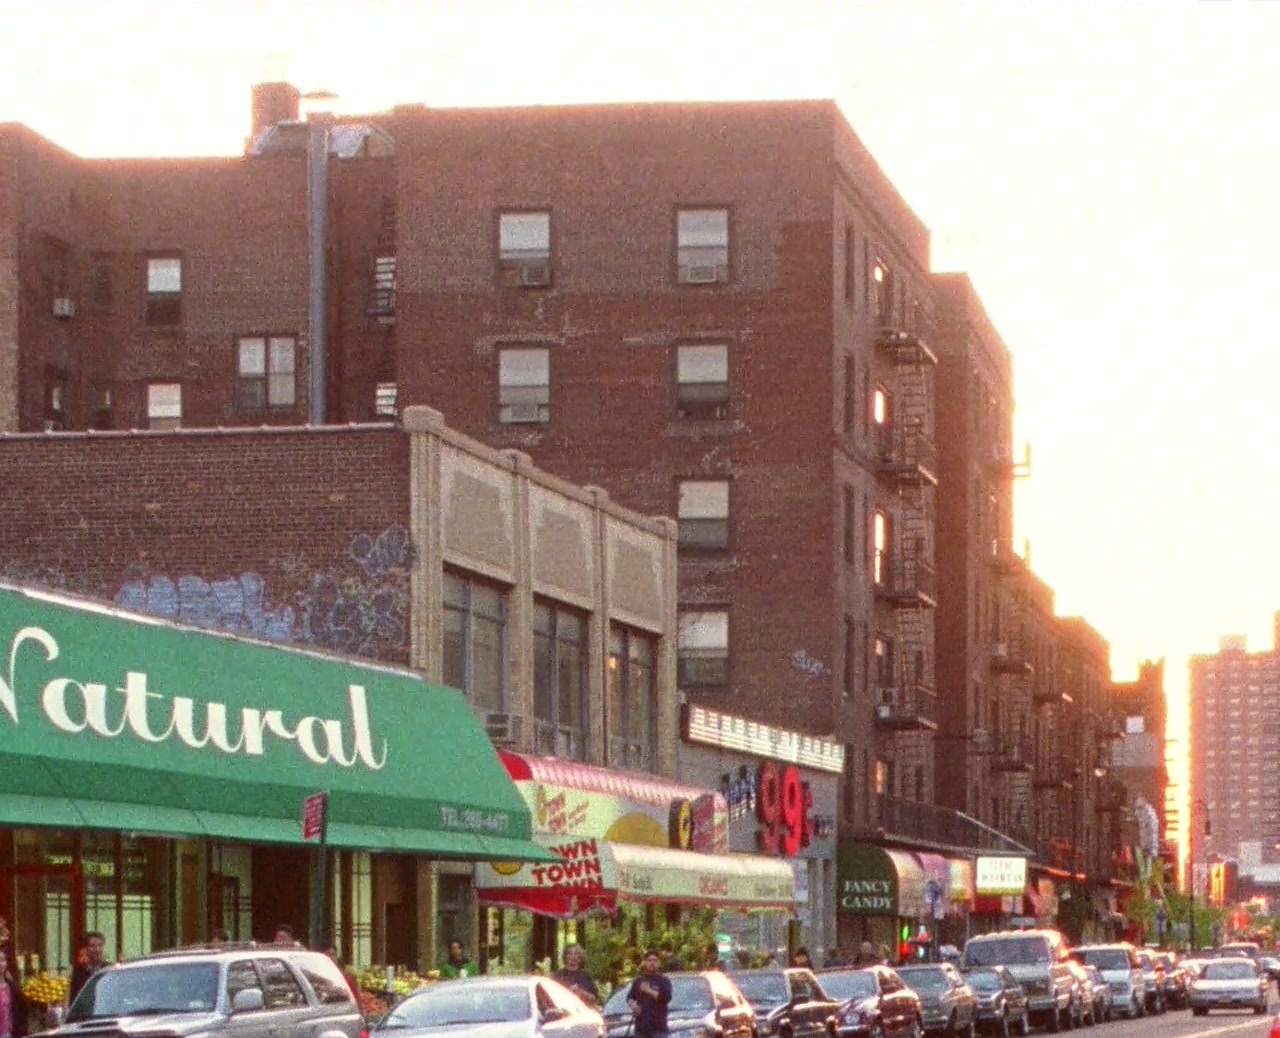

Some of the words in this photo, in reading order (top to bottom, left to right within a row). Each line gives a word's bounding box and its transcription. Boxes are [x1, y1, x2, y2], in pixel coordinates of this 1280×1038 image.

[531, 857, 602, 885] TOWN
[844, 879, 892, 894] FANCY
[841, 896, 893, 910] CANDY
